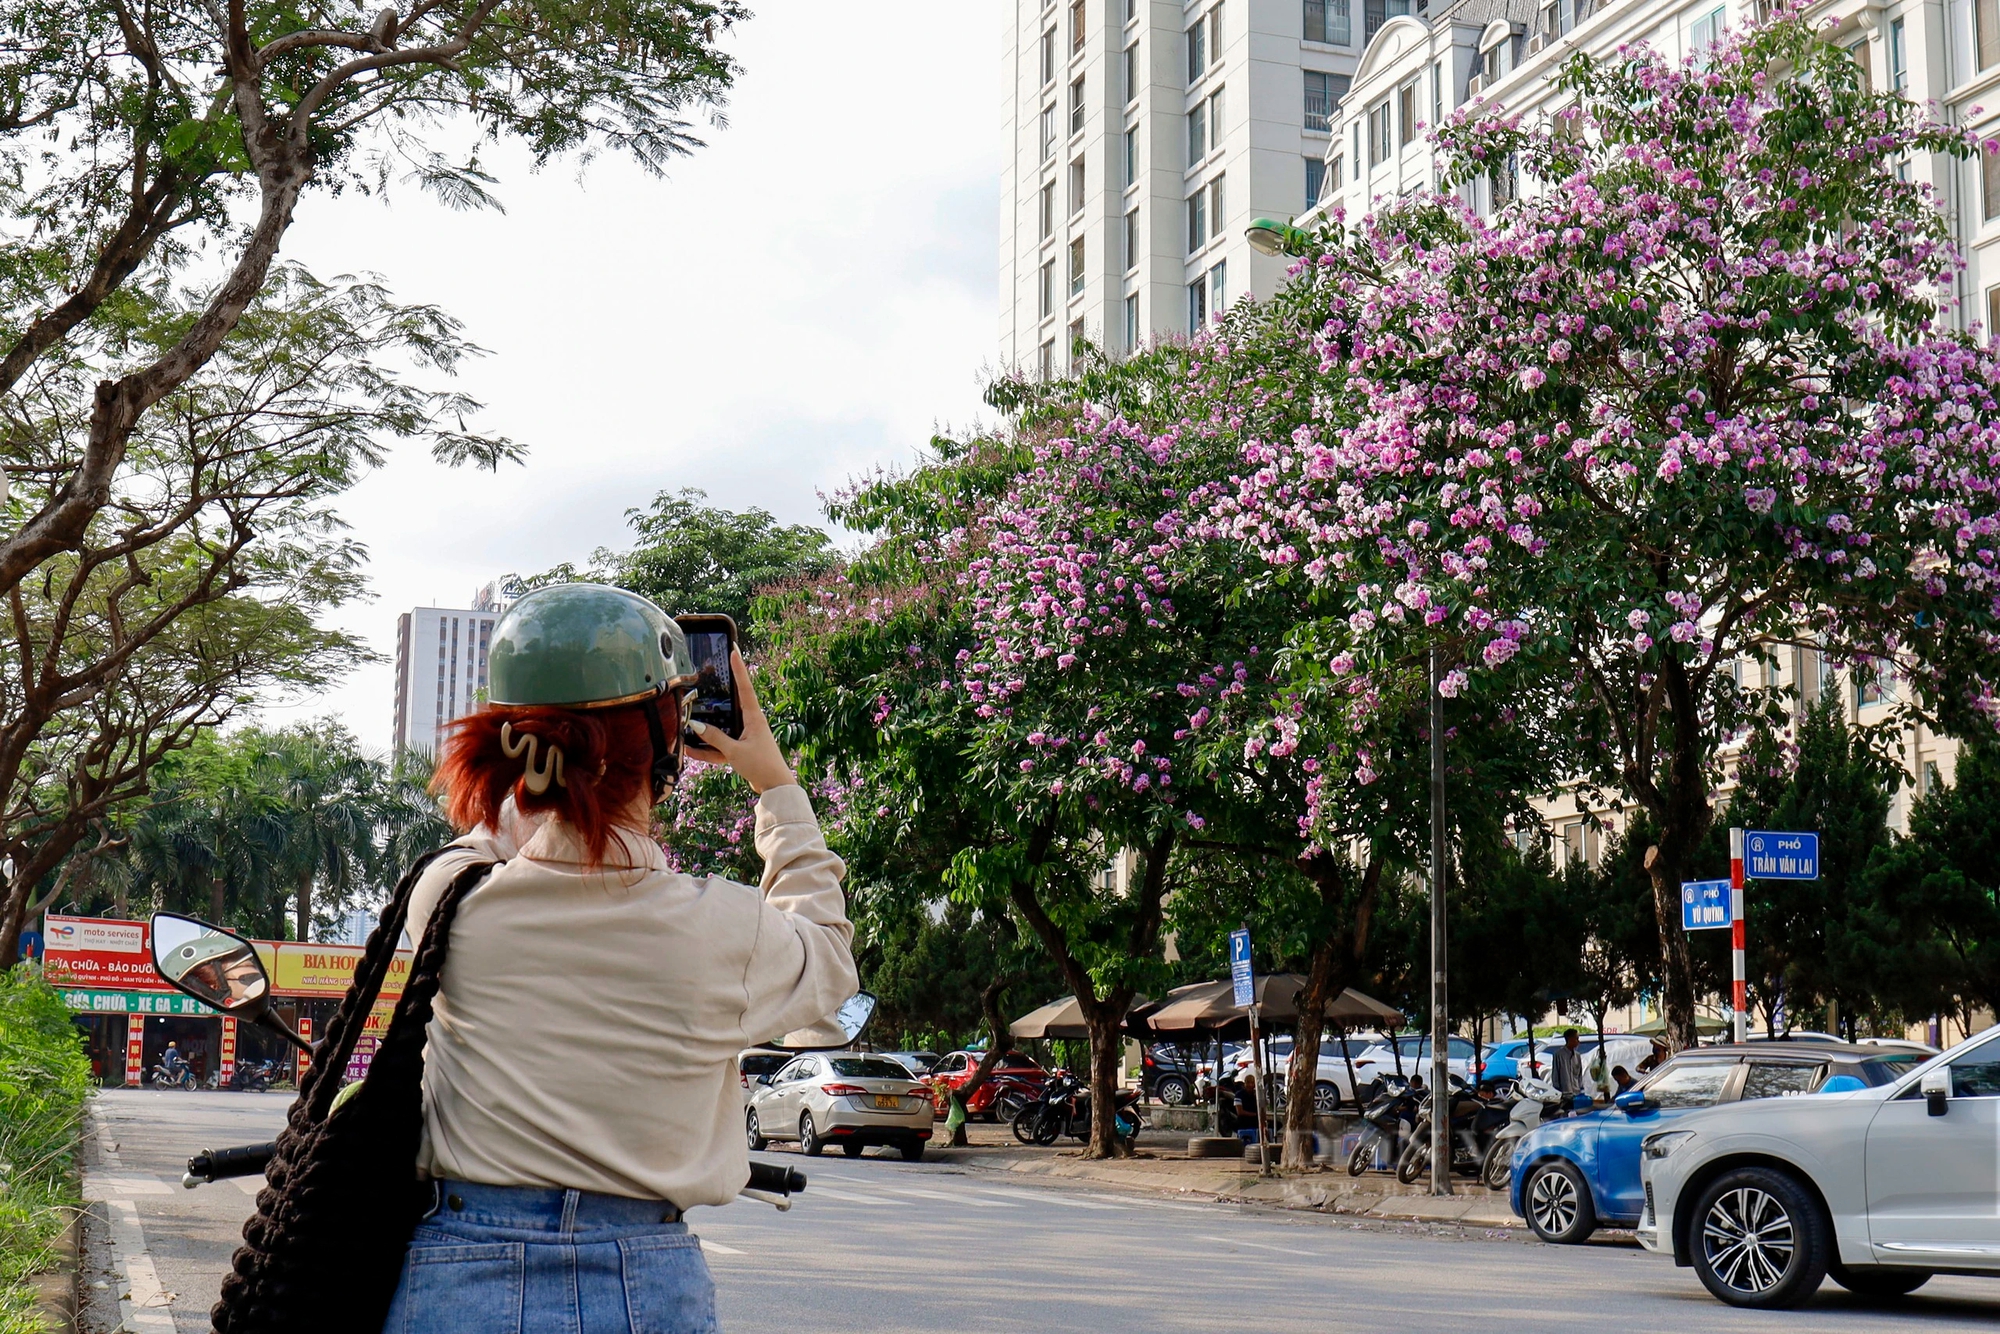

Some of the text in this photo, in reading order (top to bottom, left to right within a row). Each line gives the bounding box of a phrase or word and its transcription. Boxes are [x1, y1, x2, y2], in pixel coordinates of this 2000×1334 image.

[1778, 837, 1802, 850] PHỐ
[1752, 852, 1812, 875] TRẦN VĂN LAI
[1703, 886, 1720, 899] PHỐ
[1692, 905, 1724, 924] VŨ QUỲNH
[108, 930, 139, 939] services
[1235, 937, 1243, 961] P
[72, 959, 100, 971] CHỮA
[108, 961, 129, 973] BẢO
[132, 963, 155, 974] DƯỠ
[303, 954, 328, 970] BIA
[302, 975, 317, 985] NHÀ
[318, 976, 338, 986] HÀNG
[94, 994, 126, 1011] CHỮA
[138, 996, 152, 1012] XE
[155, 998, 170, 1012] GA
[181, 998, 196, 1013] XE
[350, 1055, 372, 1064] XE GA
[349, 1068, 368, 1077] XE S
